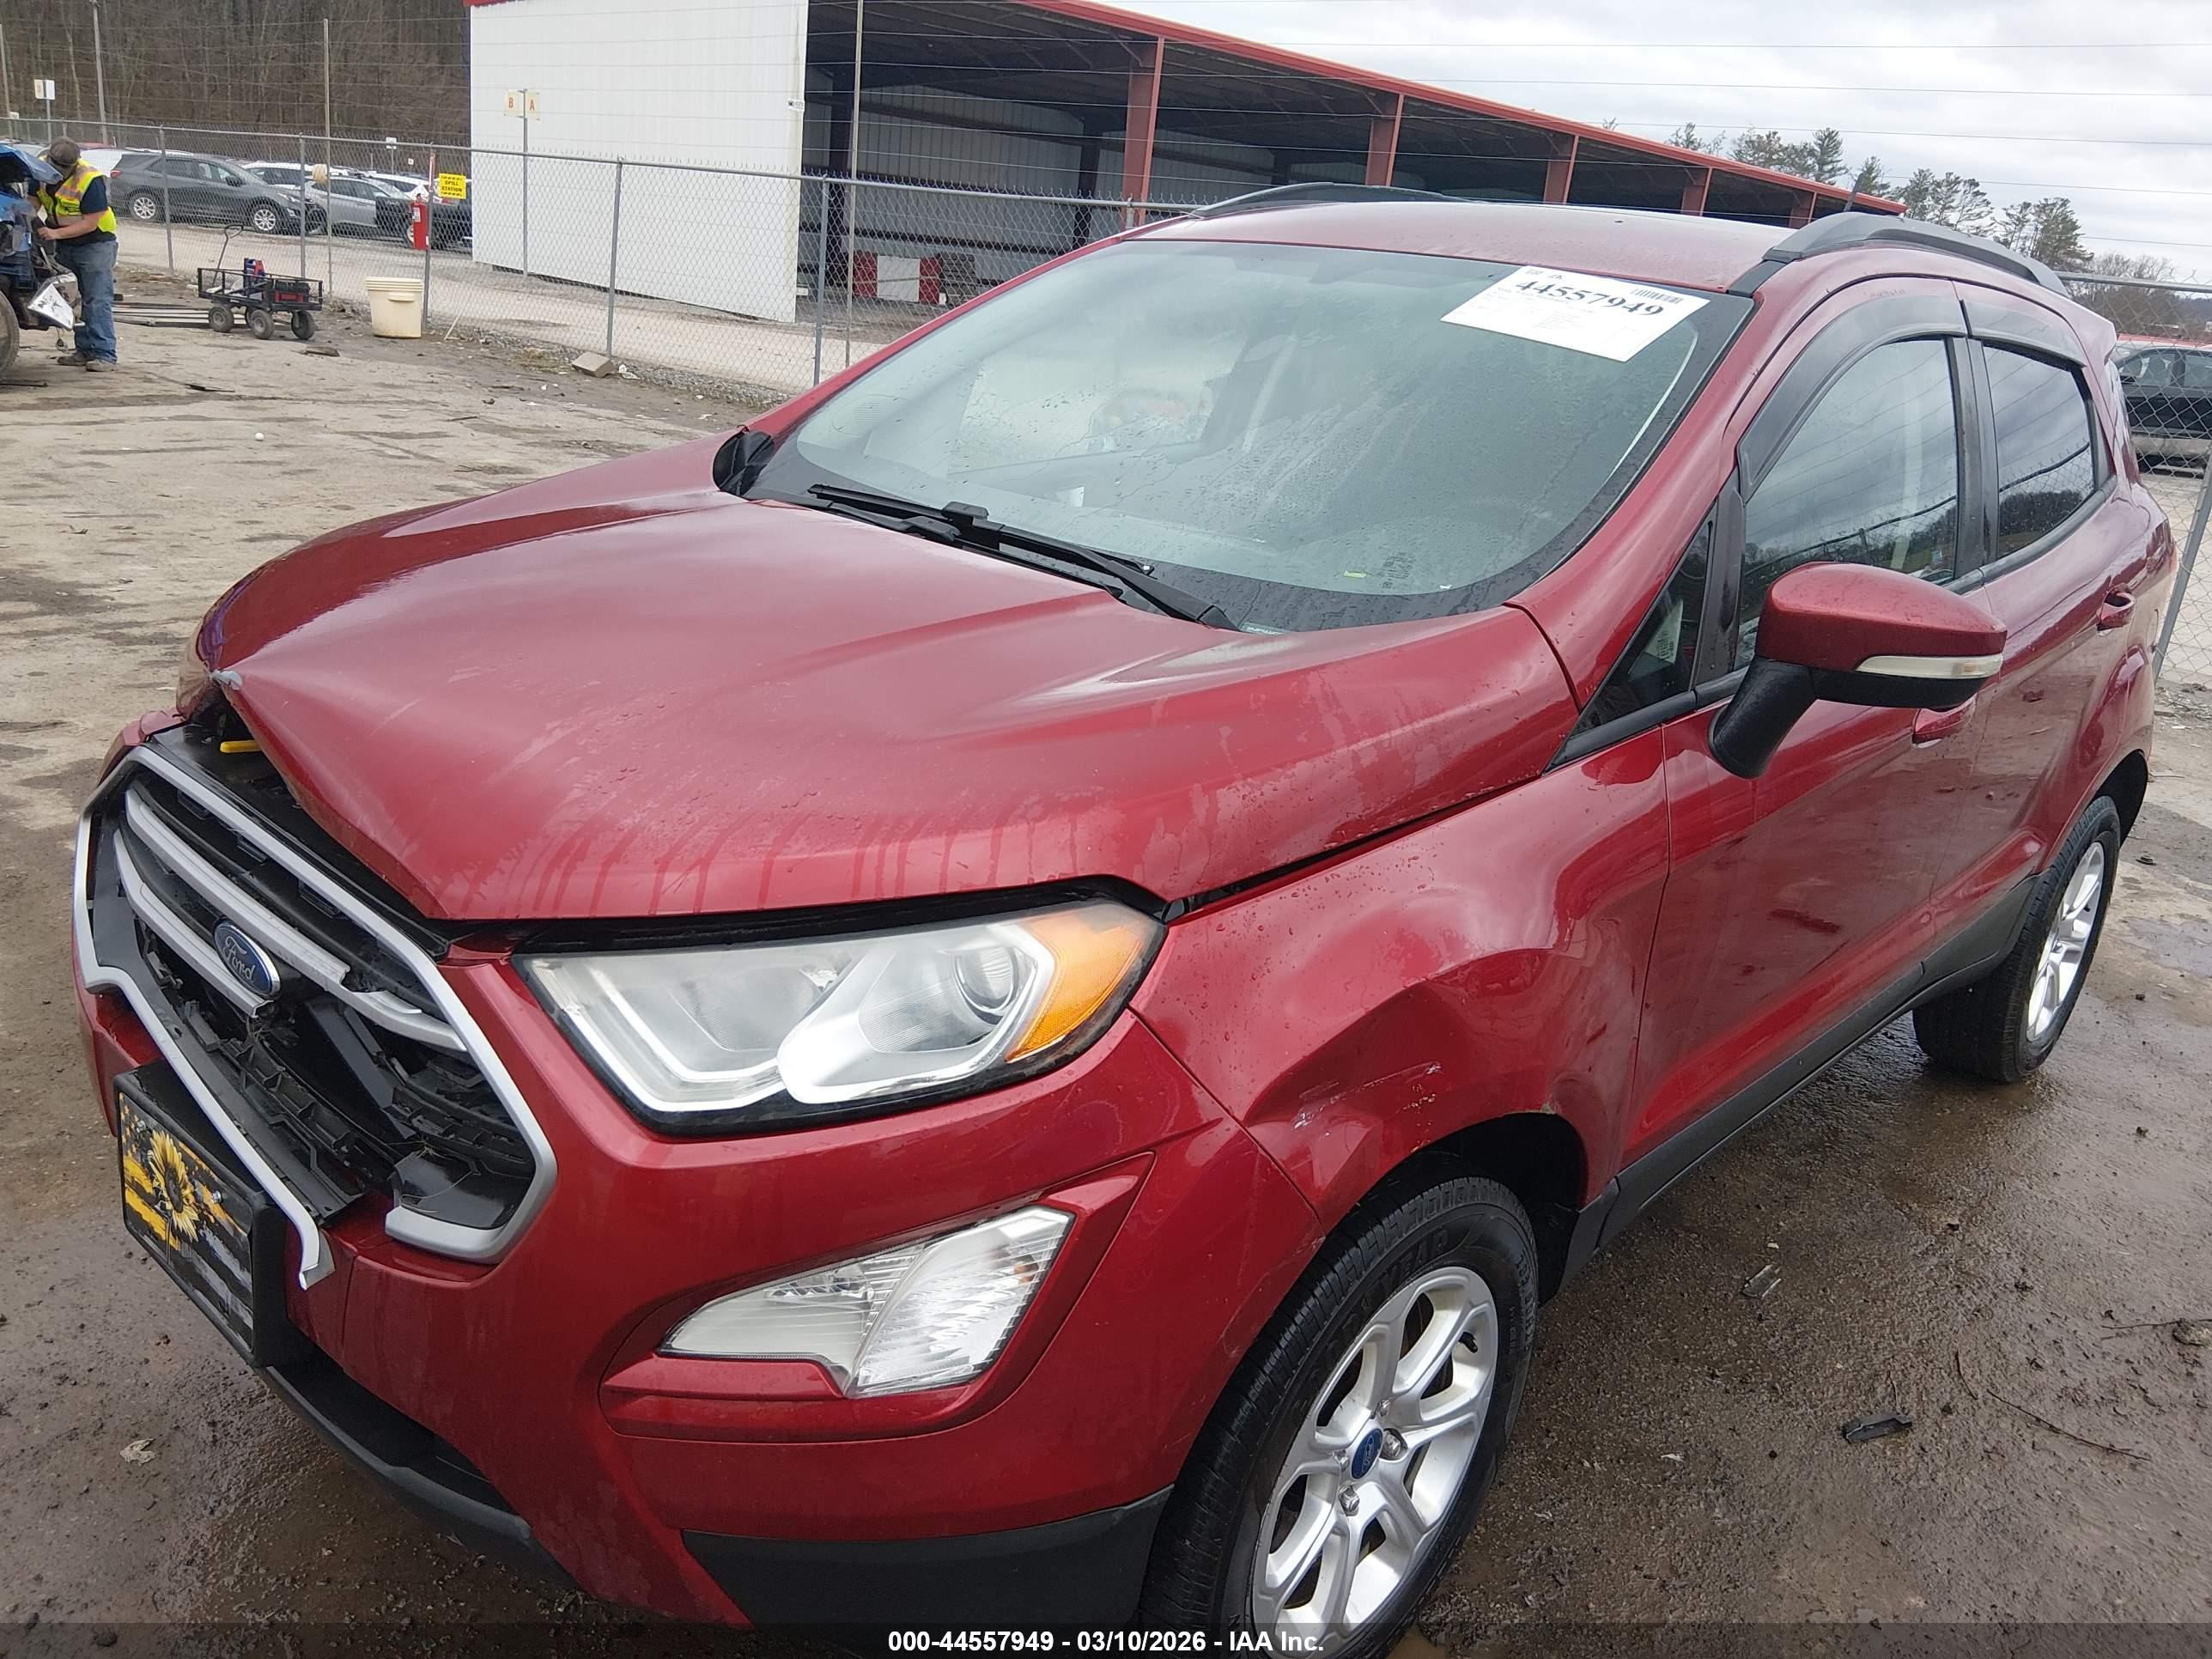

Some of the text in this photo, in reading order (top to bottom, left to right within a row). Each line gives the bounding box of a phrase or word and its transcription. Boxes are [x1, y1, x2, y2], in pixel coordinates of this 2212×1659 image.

[508, 97, 514, 108] B
[530, 99, 535, 111] A
[1516, 280, 1664, 316] 44557949
[222, 935, 256, 984] Ford
